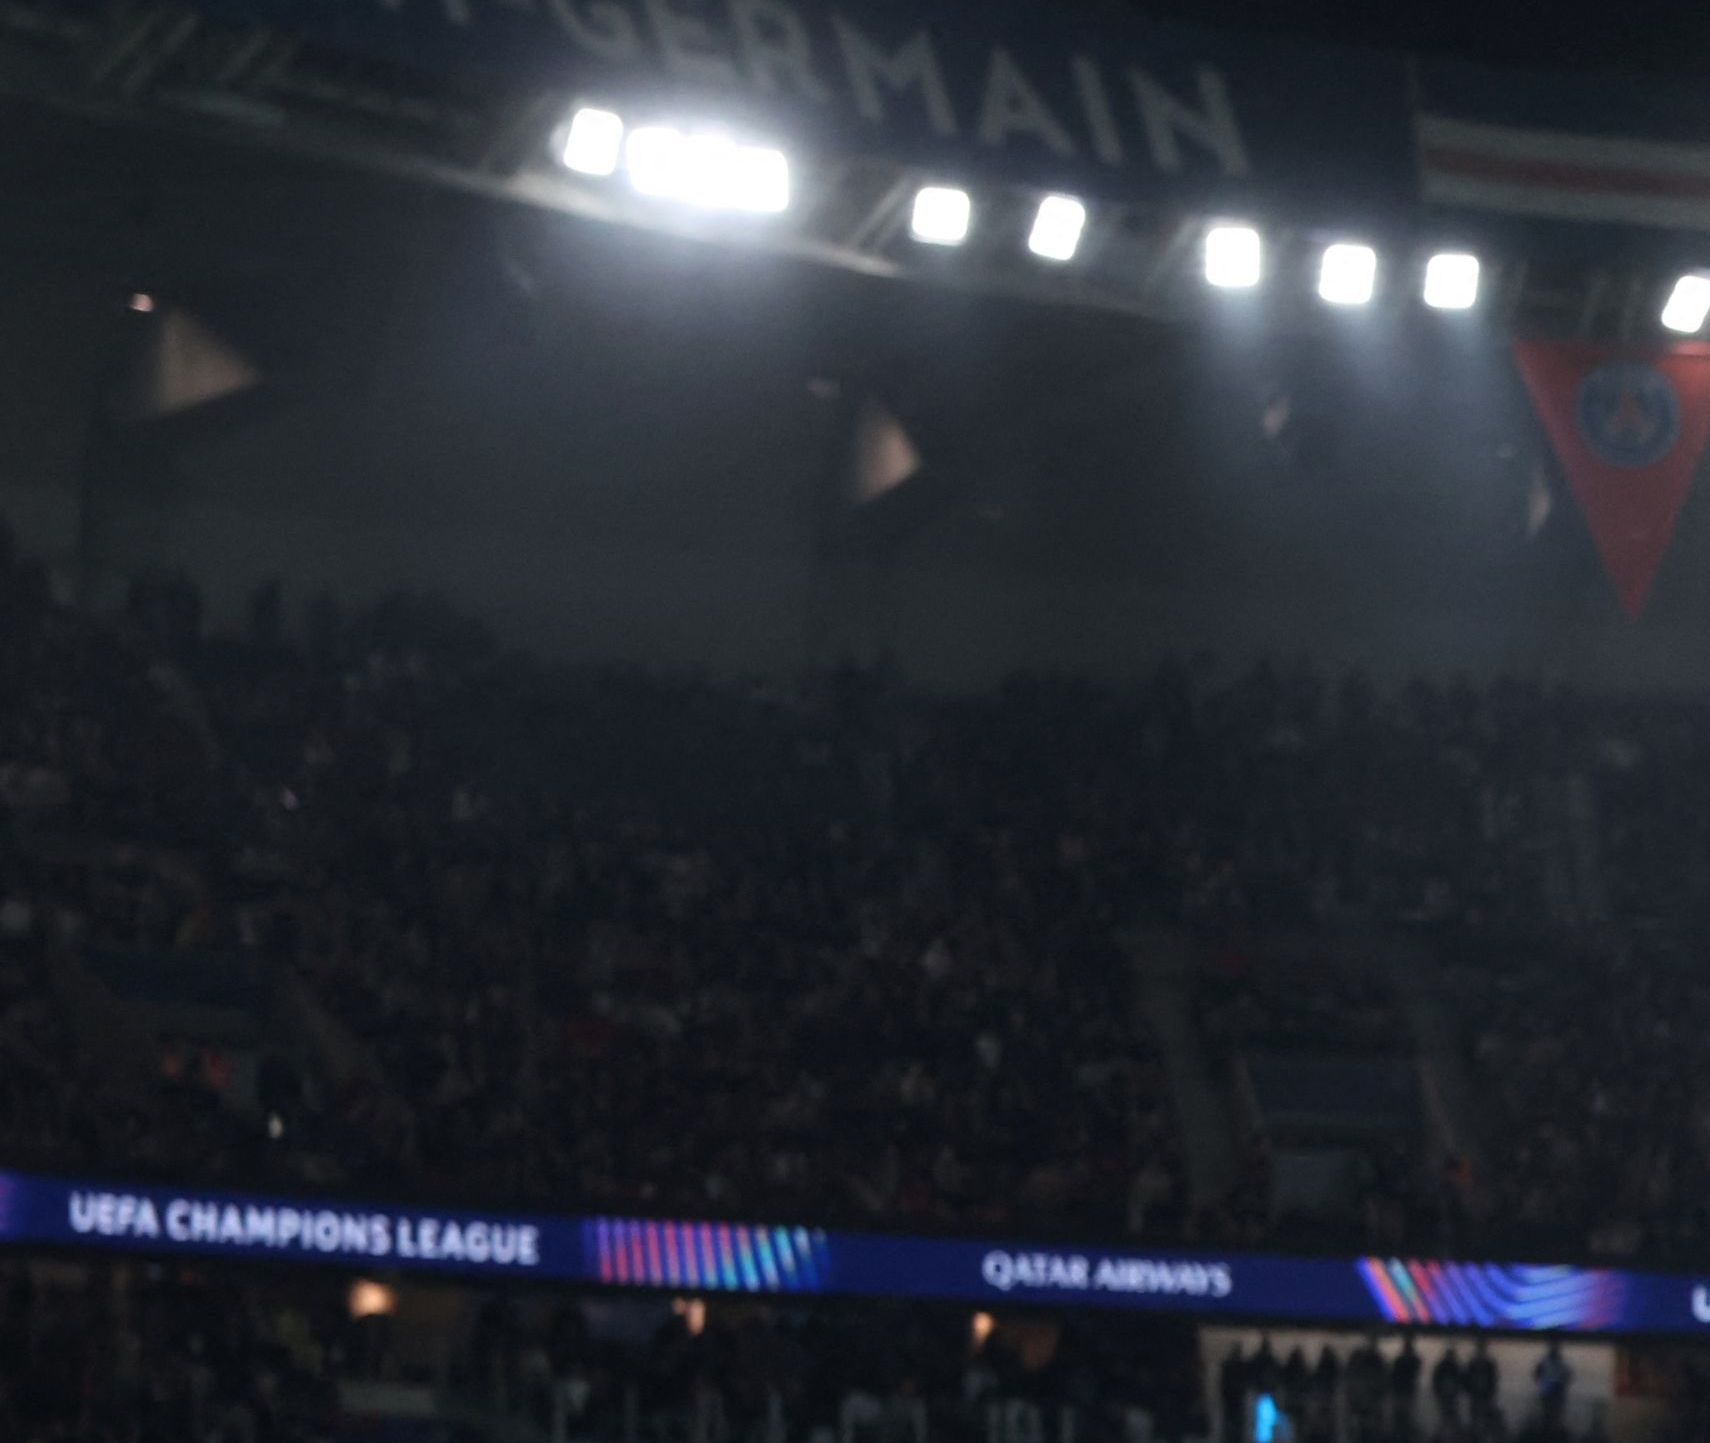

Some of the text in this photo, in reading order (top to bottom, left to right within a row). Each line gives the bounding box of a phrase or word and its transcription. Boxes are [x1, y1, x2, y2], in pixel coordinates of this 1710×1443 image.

[67, 1190, 541, 1267] UEFA CHAMPIONS LEAGUE
[981, 1250, 1233, 1298] QATAR AIRWAYS
